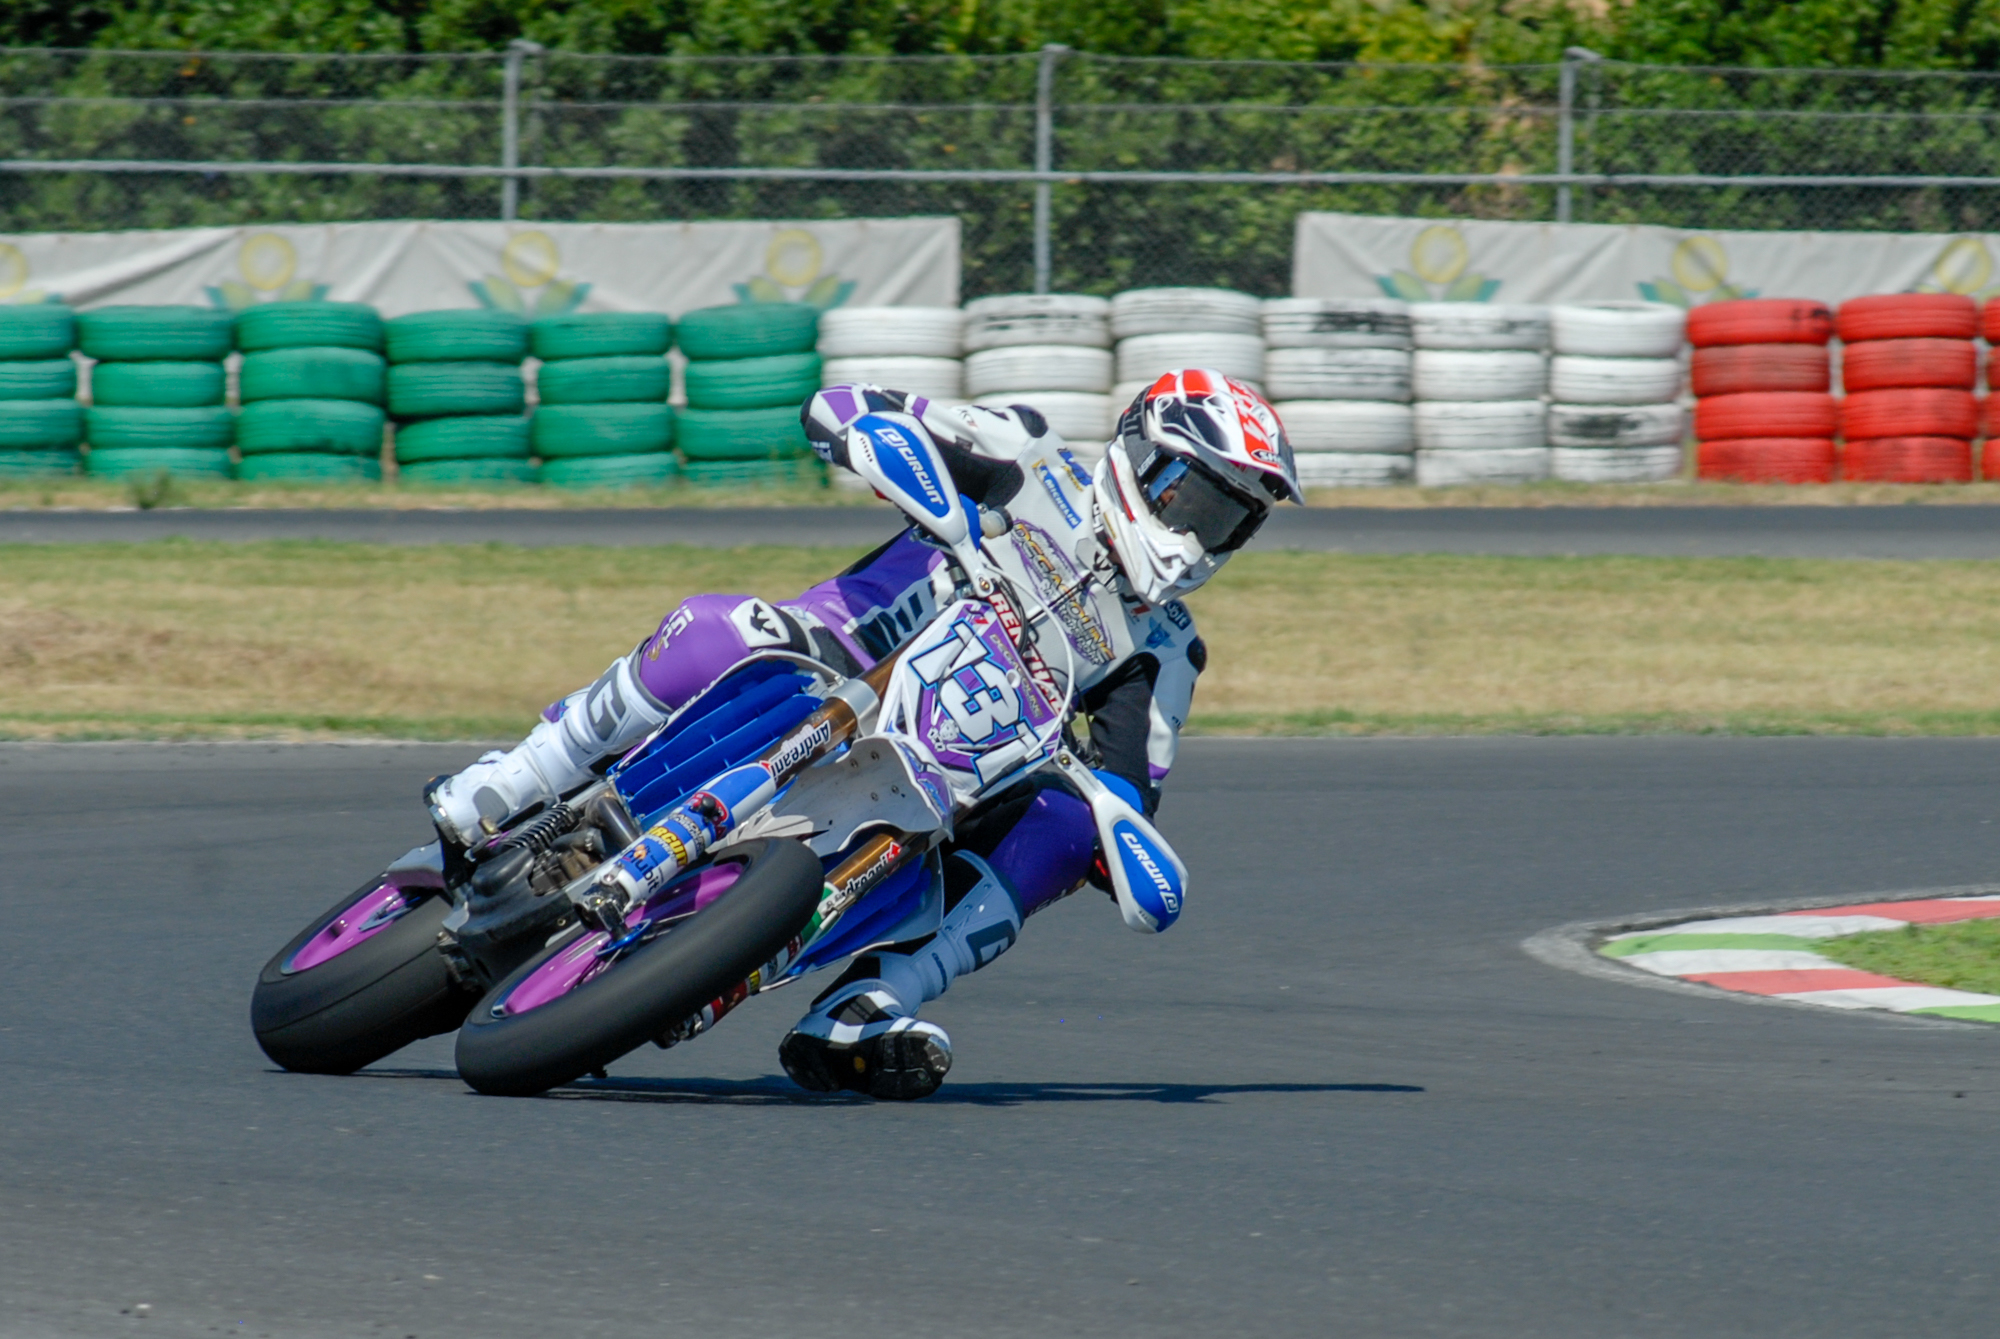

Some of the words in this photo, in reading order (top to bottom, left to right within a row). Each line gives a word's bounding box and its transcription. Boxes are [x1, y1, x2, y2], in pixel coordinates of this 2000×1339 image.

[898, 447, 945, 506] CIRCUIT
[1044, 478, 1079, 526] MICHELIN
[907, 615, 1049, 785] 131
[769, 720, 831, 782] Andreani
[647, 826, 686, 866] IRCUIT
[1120, 832, 1171, 892] CIRCUIT
